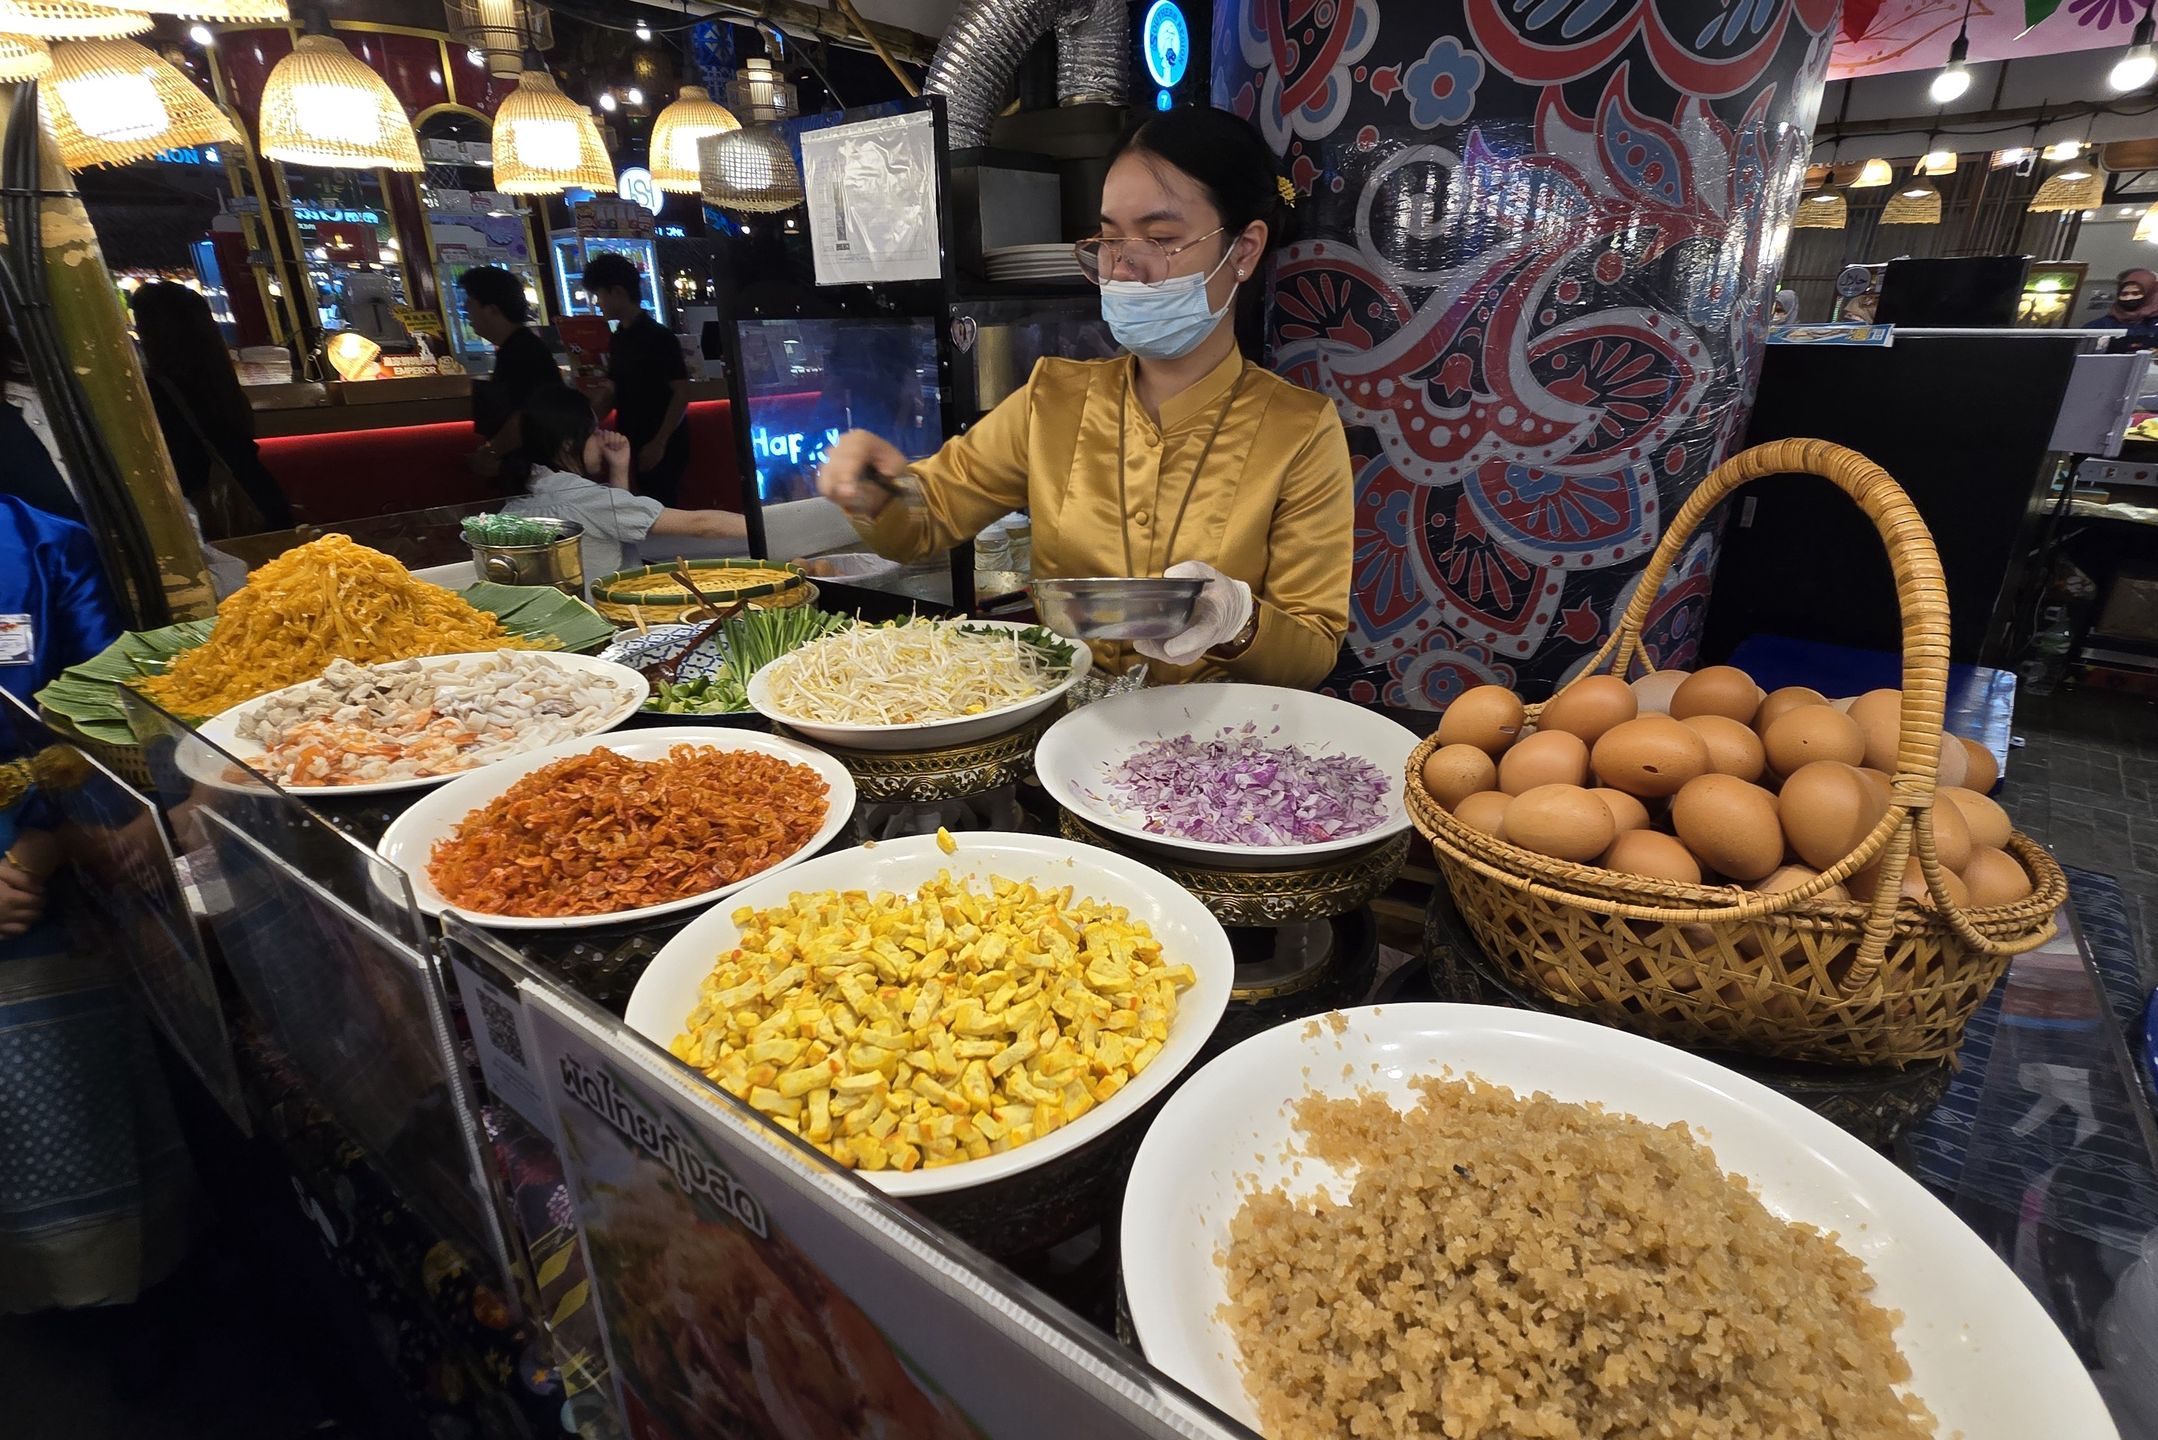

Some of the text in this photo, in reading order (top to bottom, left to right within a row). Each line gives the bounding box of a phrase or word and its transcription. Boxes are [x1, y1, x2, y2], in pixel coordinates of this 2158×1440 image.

[393, 366, 438, 376] EMPEROR
[559, 1052, 768, 1238] ผัดไทยกุ้งสด
